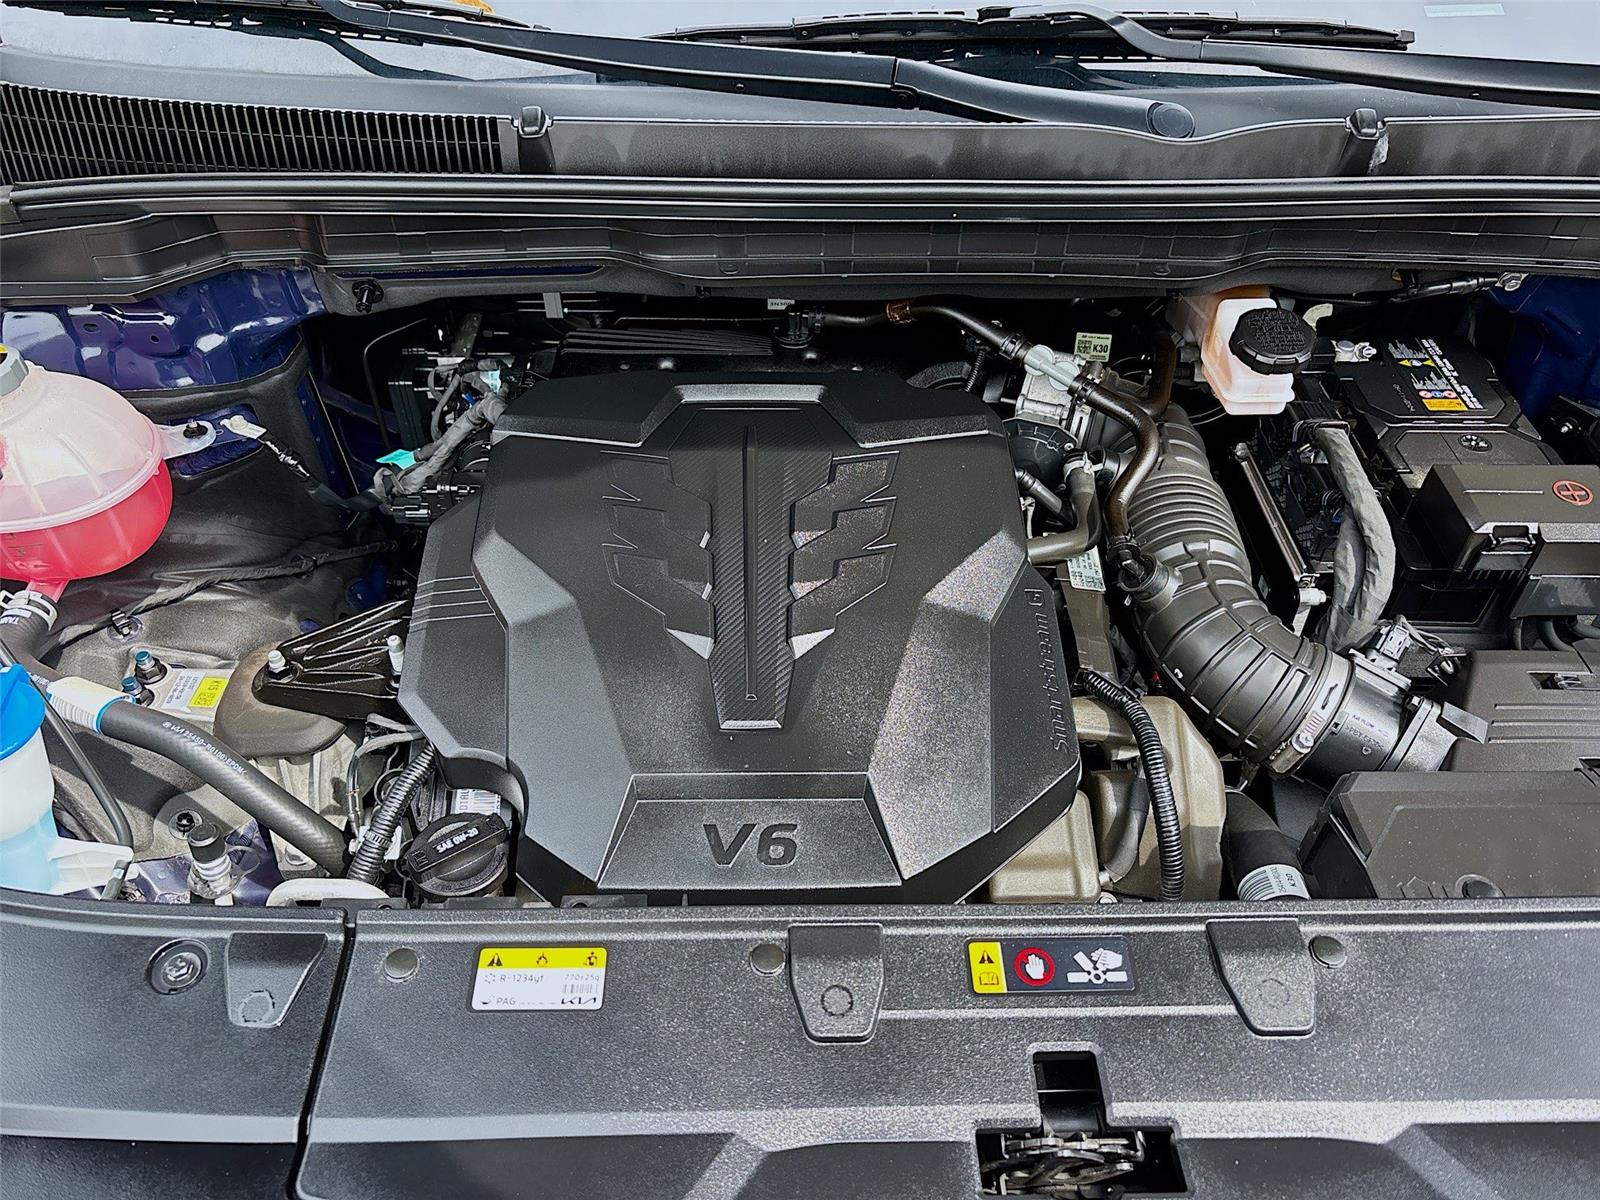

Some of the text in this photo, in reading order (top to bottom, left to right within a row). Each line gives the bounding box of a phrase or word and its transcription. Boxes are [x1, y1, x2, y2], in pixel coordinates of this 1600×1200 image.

[1092, 344, 1109, 353] K30
[435, 827, 479, 854] SAE 0W-20
[702, 822, 798, 868] V6
[499, 974, 545, 984] R-1234yf
[496, 996, 597, 1006] PAG KIA
